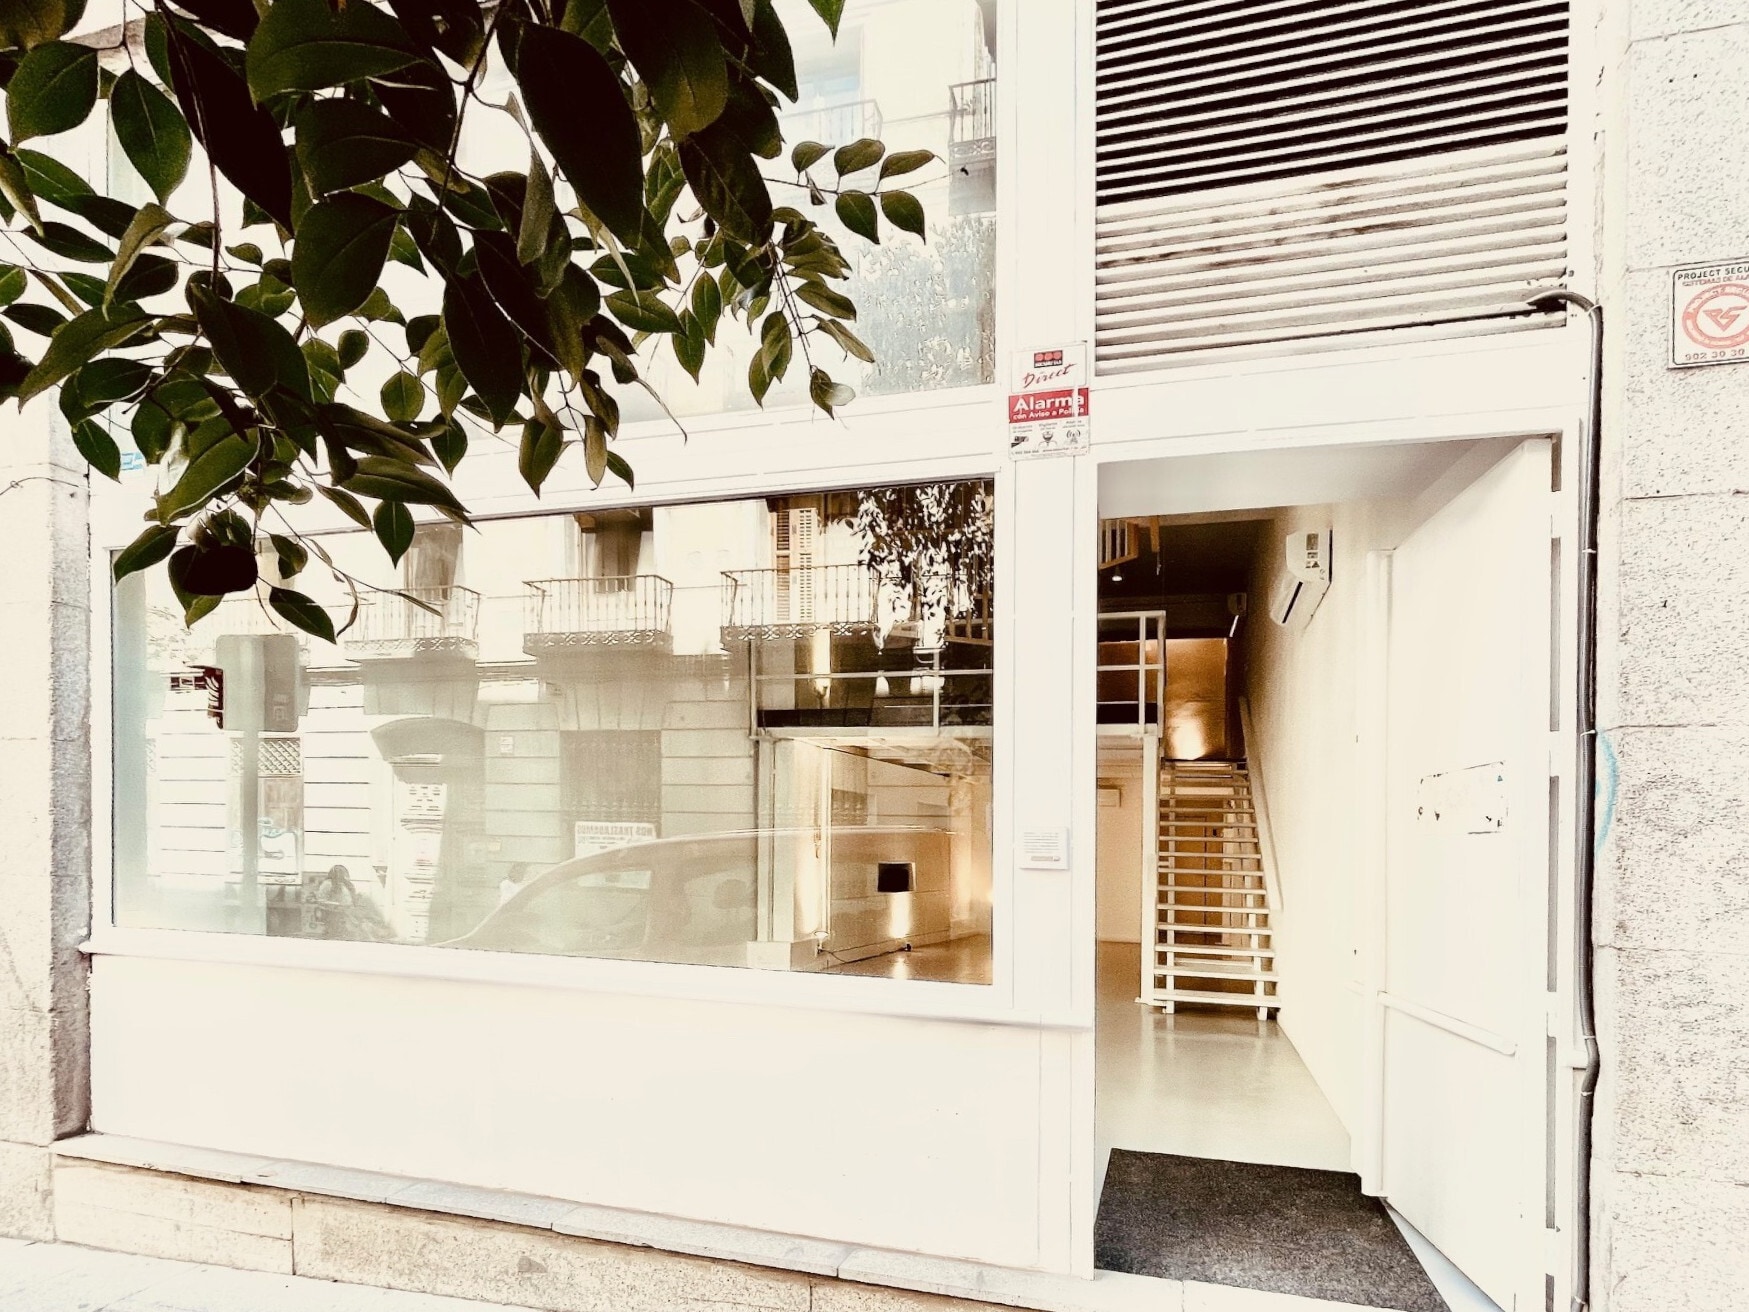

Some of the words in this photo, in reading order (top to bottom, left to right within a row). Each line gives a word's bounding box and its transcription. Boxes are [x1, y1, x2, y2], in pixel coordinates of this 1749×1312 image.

[1677, 269, 1721, 280] PROJECT
[1685, 352, 1708, 361] 902
[1711, 350, 1726, 358] 30
[1730, 348, 1745, 357] 30
[1022, 363, 1077, 389] Direct
[1012, 412, 1027, 421] con
[1028, 411, 1050, 419] Aviso
